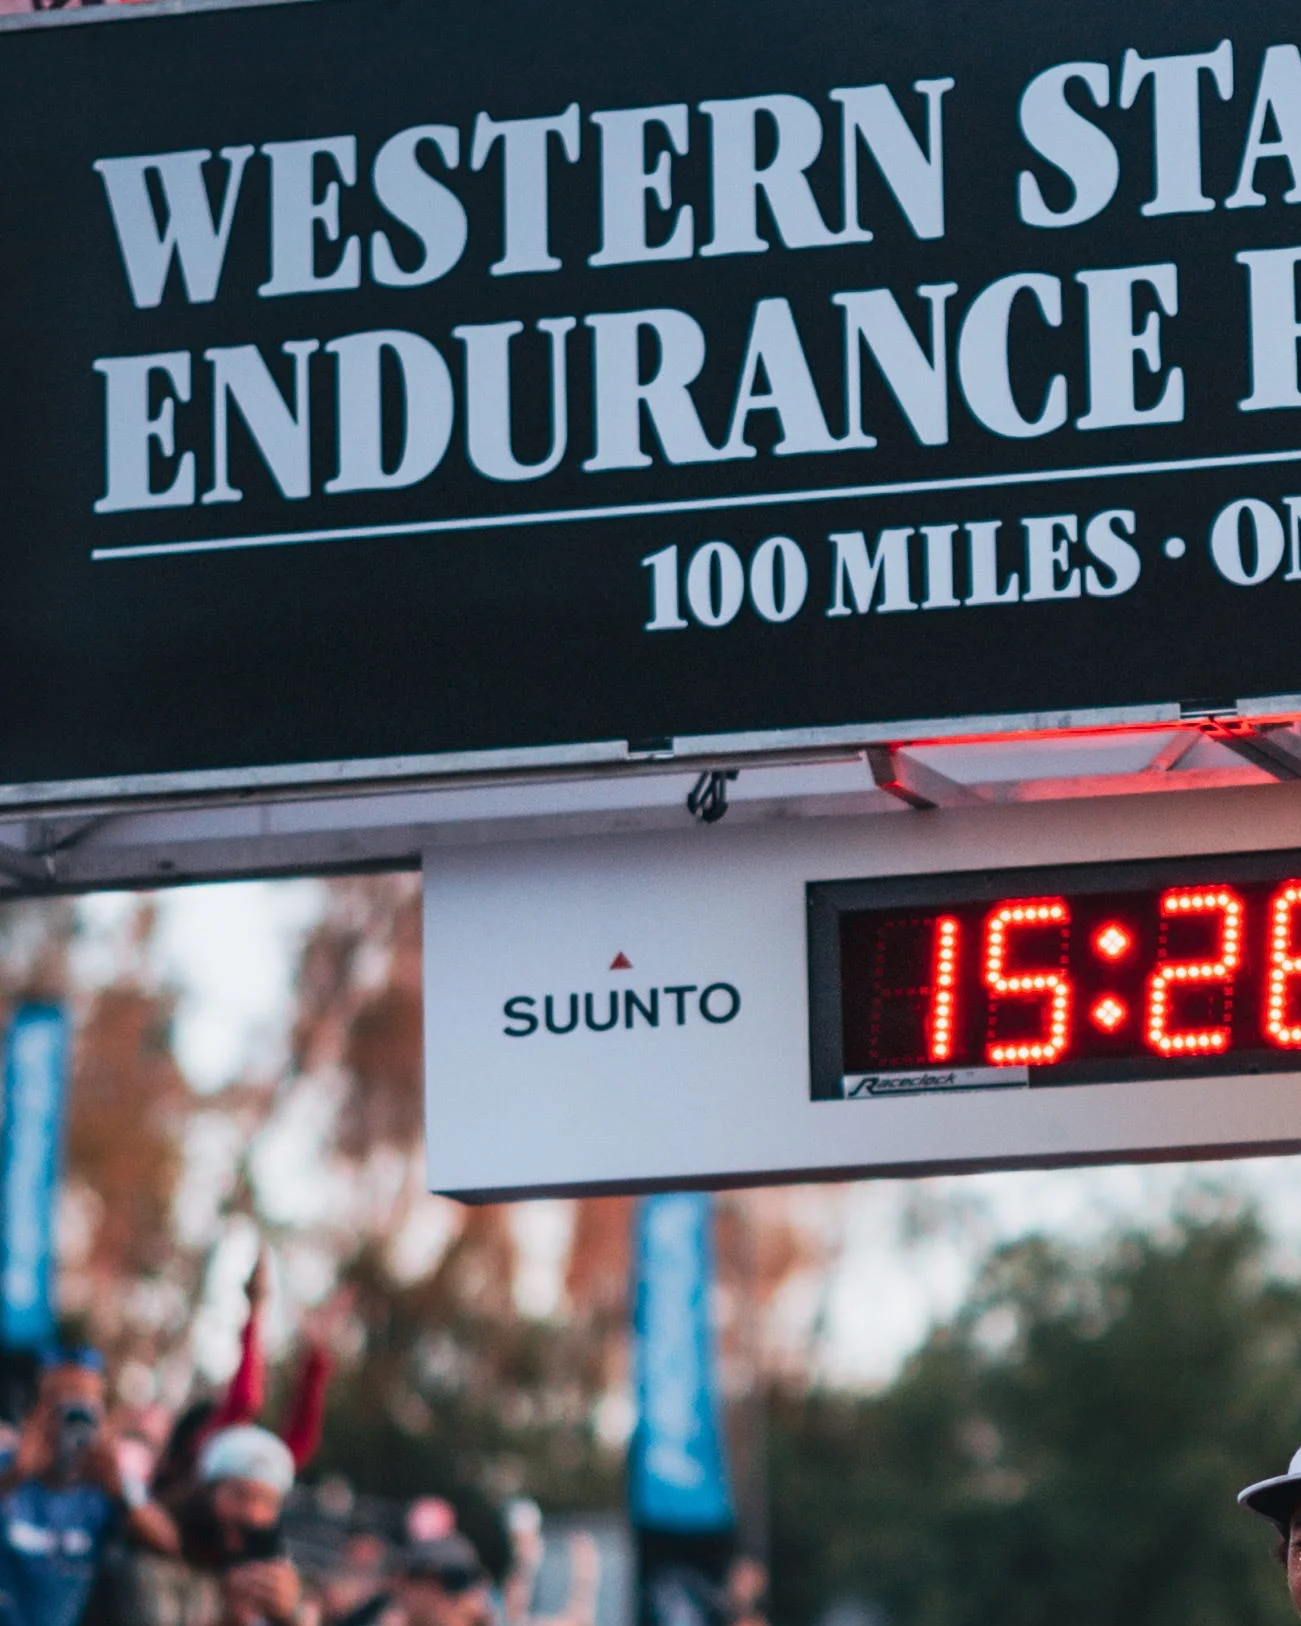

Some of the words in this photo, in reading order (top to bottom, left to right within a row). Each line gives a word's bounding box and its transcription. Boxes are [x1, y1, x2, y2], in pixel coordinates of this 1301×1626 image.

[94, 78, 955, 307] WESTERN
[93, 264, 1184, 513] ENDURANCE
[643, 536, 808, 630] 100
[827, 510, 1142, 617] MILES
[503, 982, 741, 1038] SUUNTO
